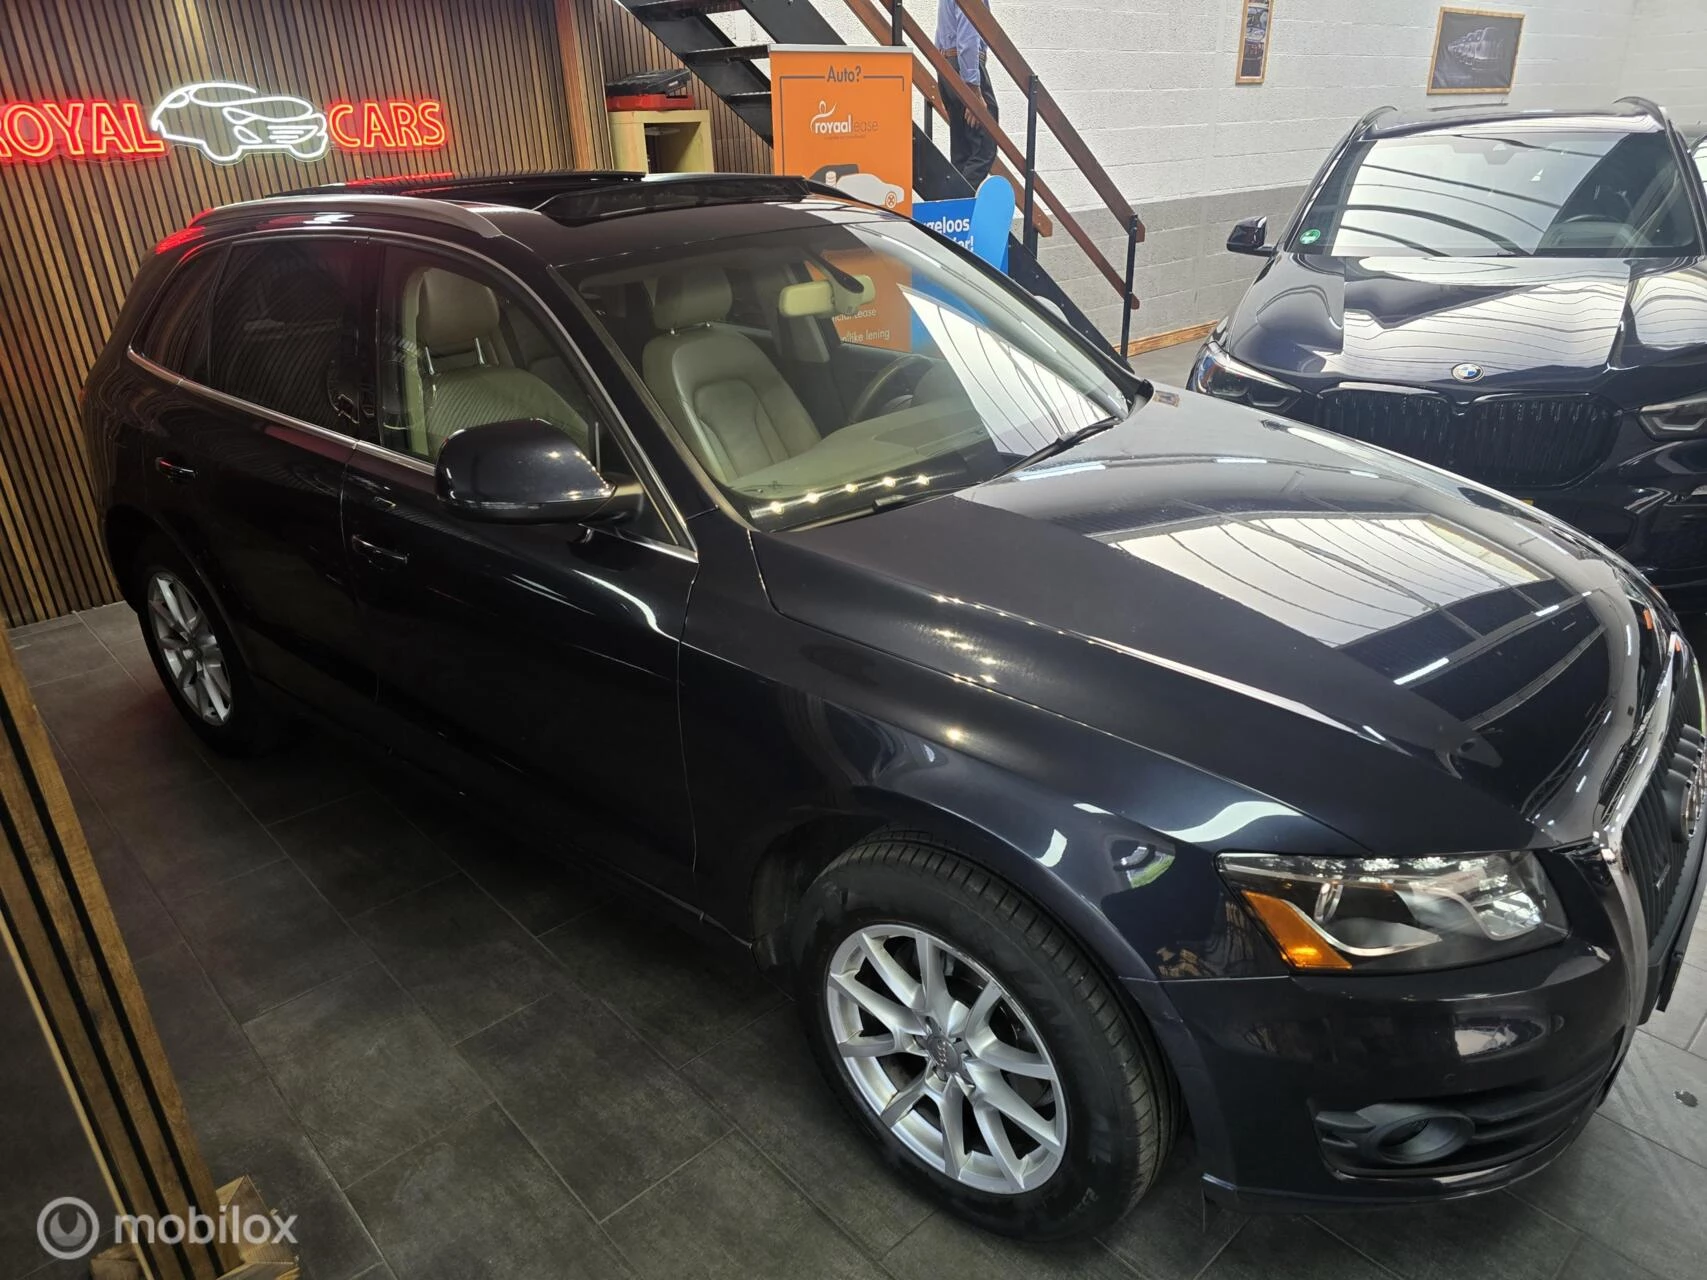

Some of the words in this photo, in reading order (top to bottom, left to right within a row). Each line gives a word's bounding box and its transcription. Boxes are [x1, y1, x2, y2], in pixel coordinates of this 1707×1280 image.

[826, 65, 862, 83] Auto?
[0, 102, 165, 158] OYAL
[329, 102, 445, 148] CARS
[923, 216, 970, 234] geloos
